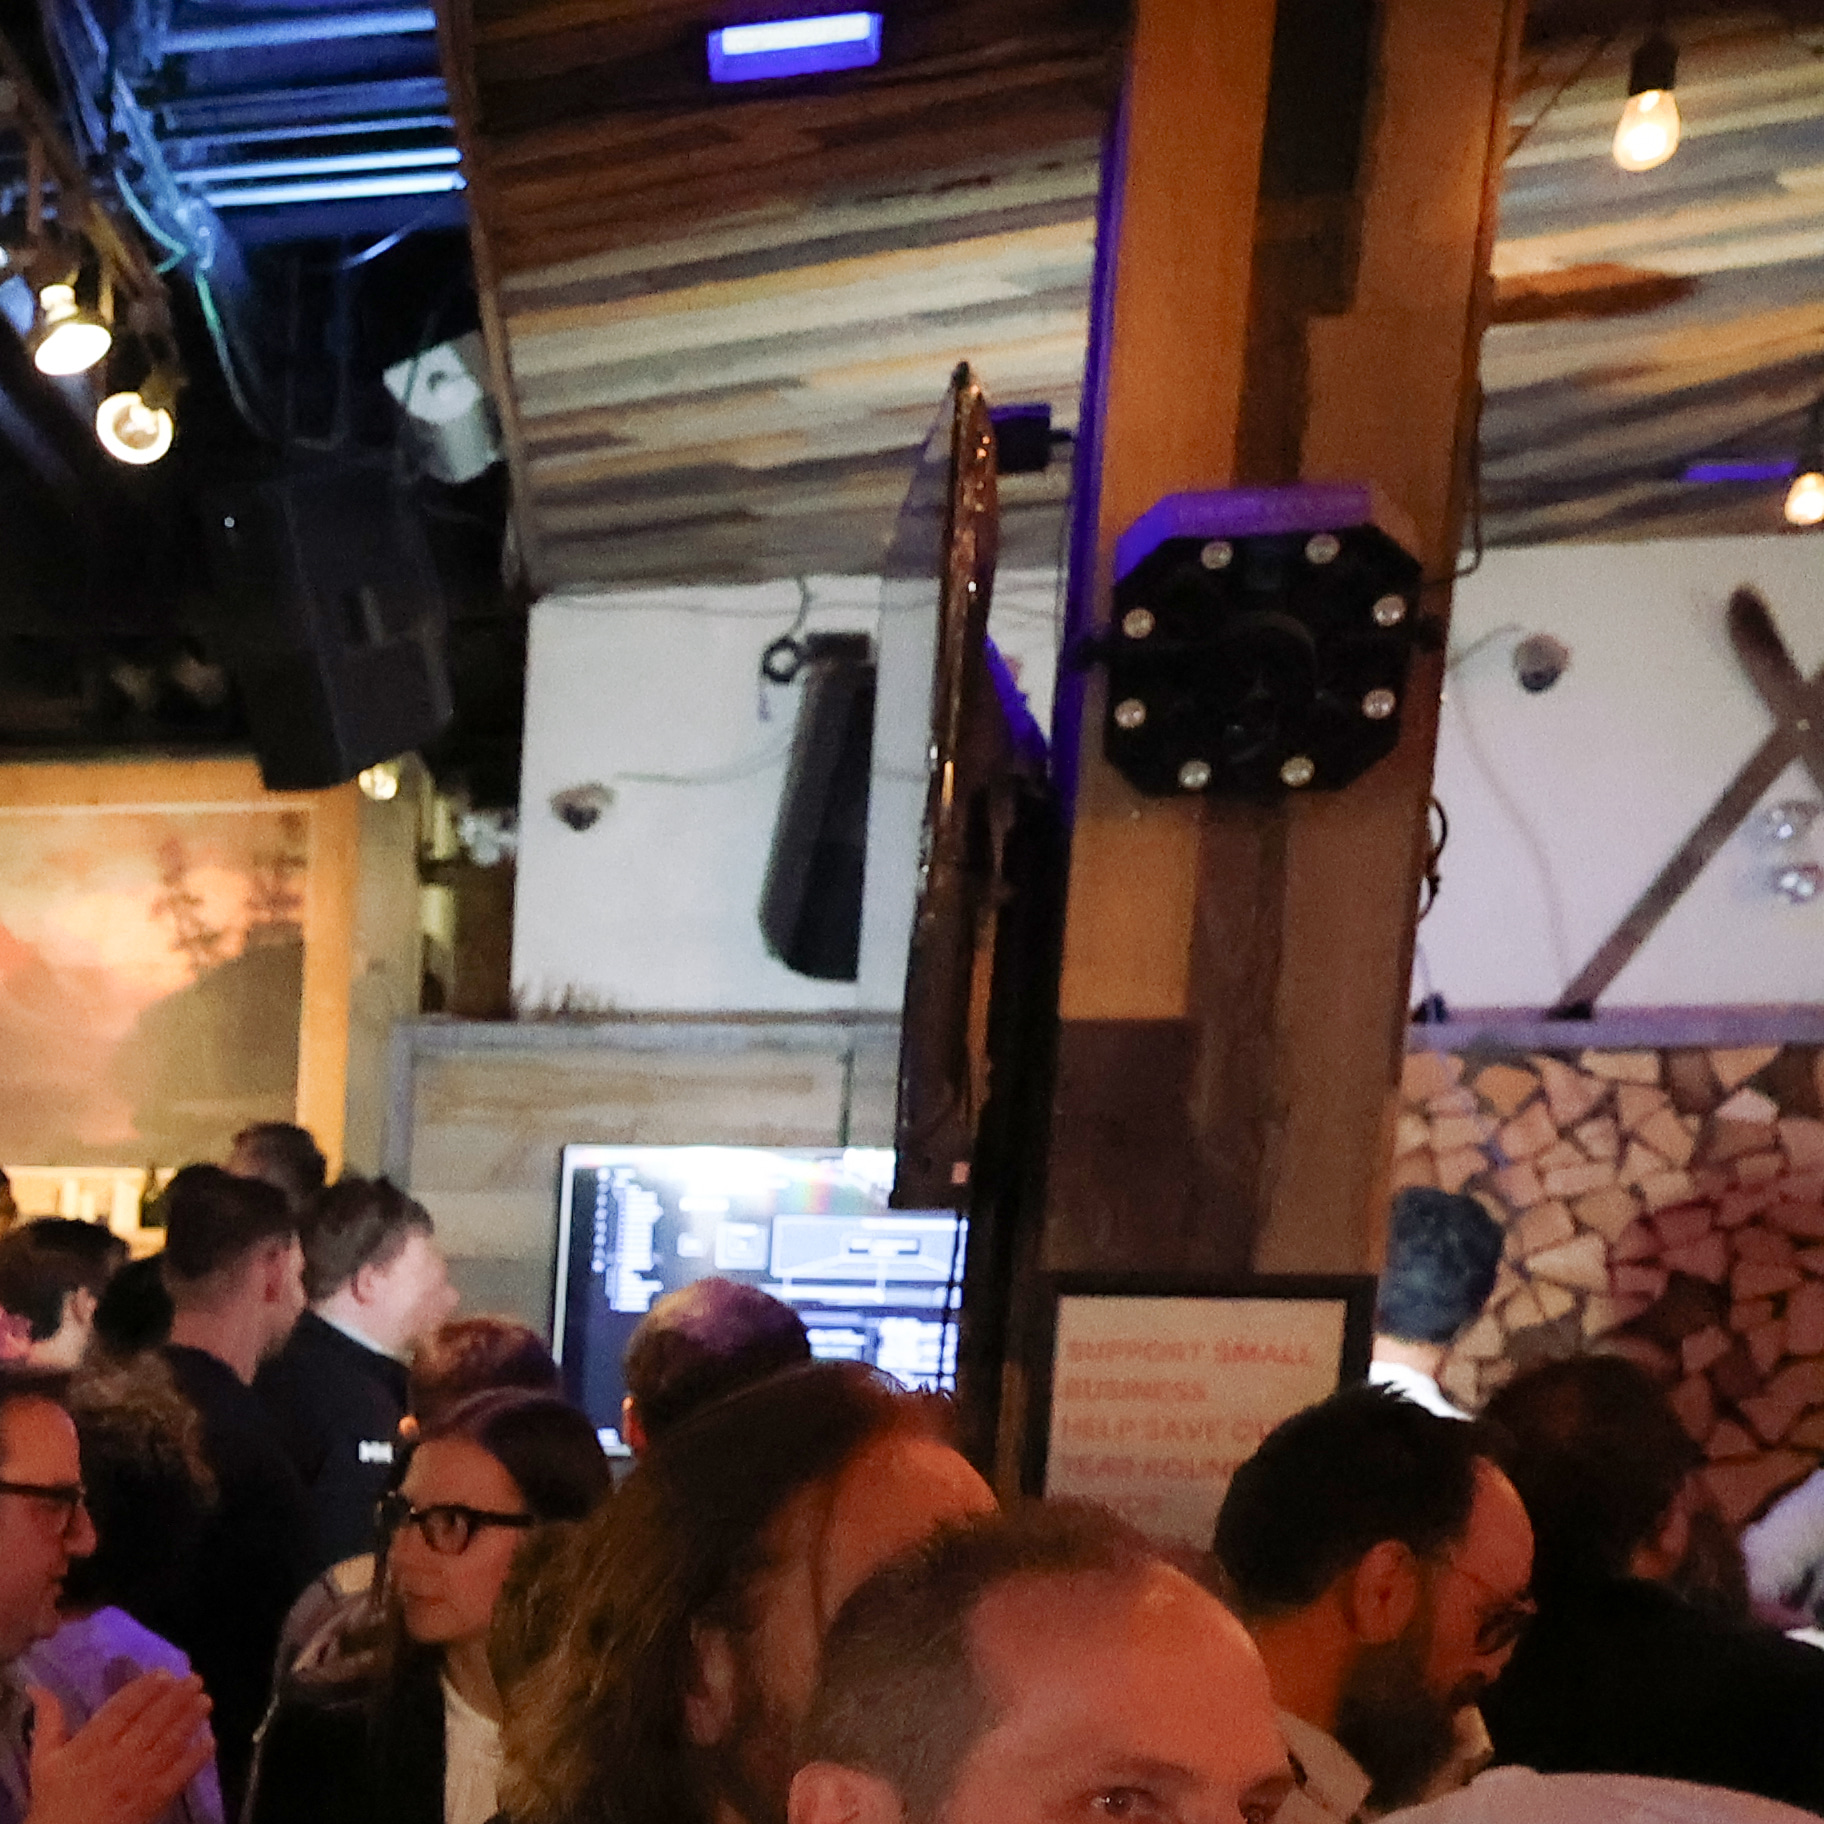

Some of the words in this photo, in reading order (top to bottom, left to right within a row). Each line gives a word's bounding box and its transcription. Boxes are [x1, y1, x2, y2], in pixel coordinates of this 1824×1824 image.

[1066, 1339, 1206, 1363] SUPPORT
[1213, 1339, 1314, 1366] SMALL
[1063, 1377, 1208, 1401] BUSINESS
[1061, 1416, 1136, 1440] HELP
[1144, 1417, 1222, 1441] SAVE
